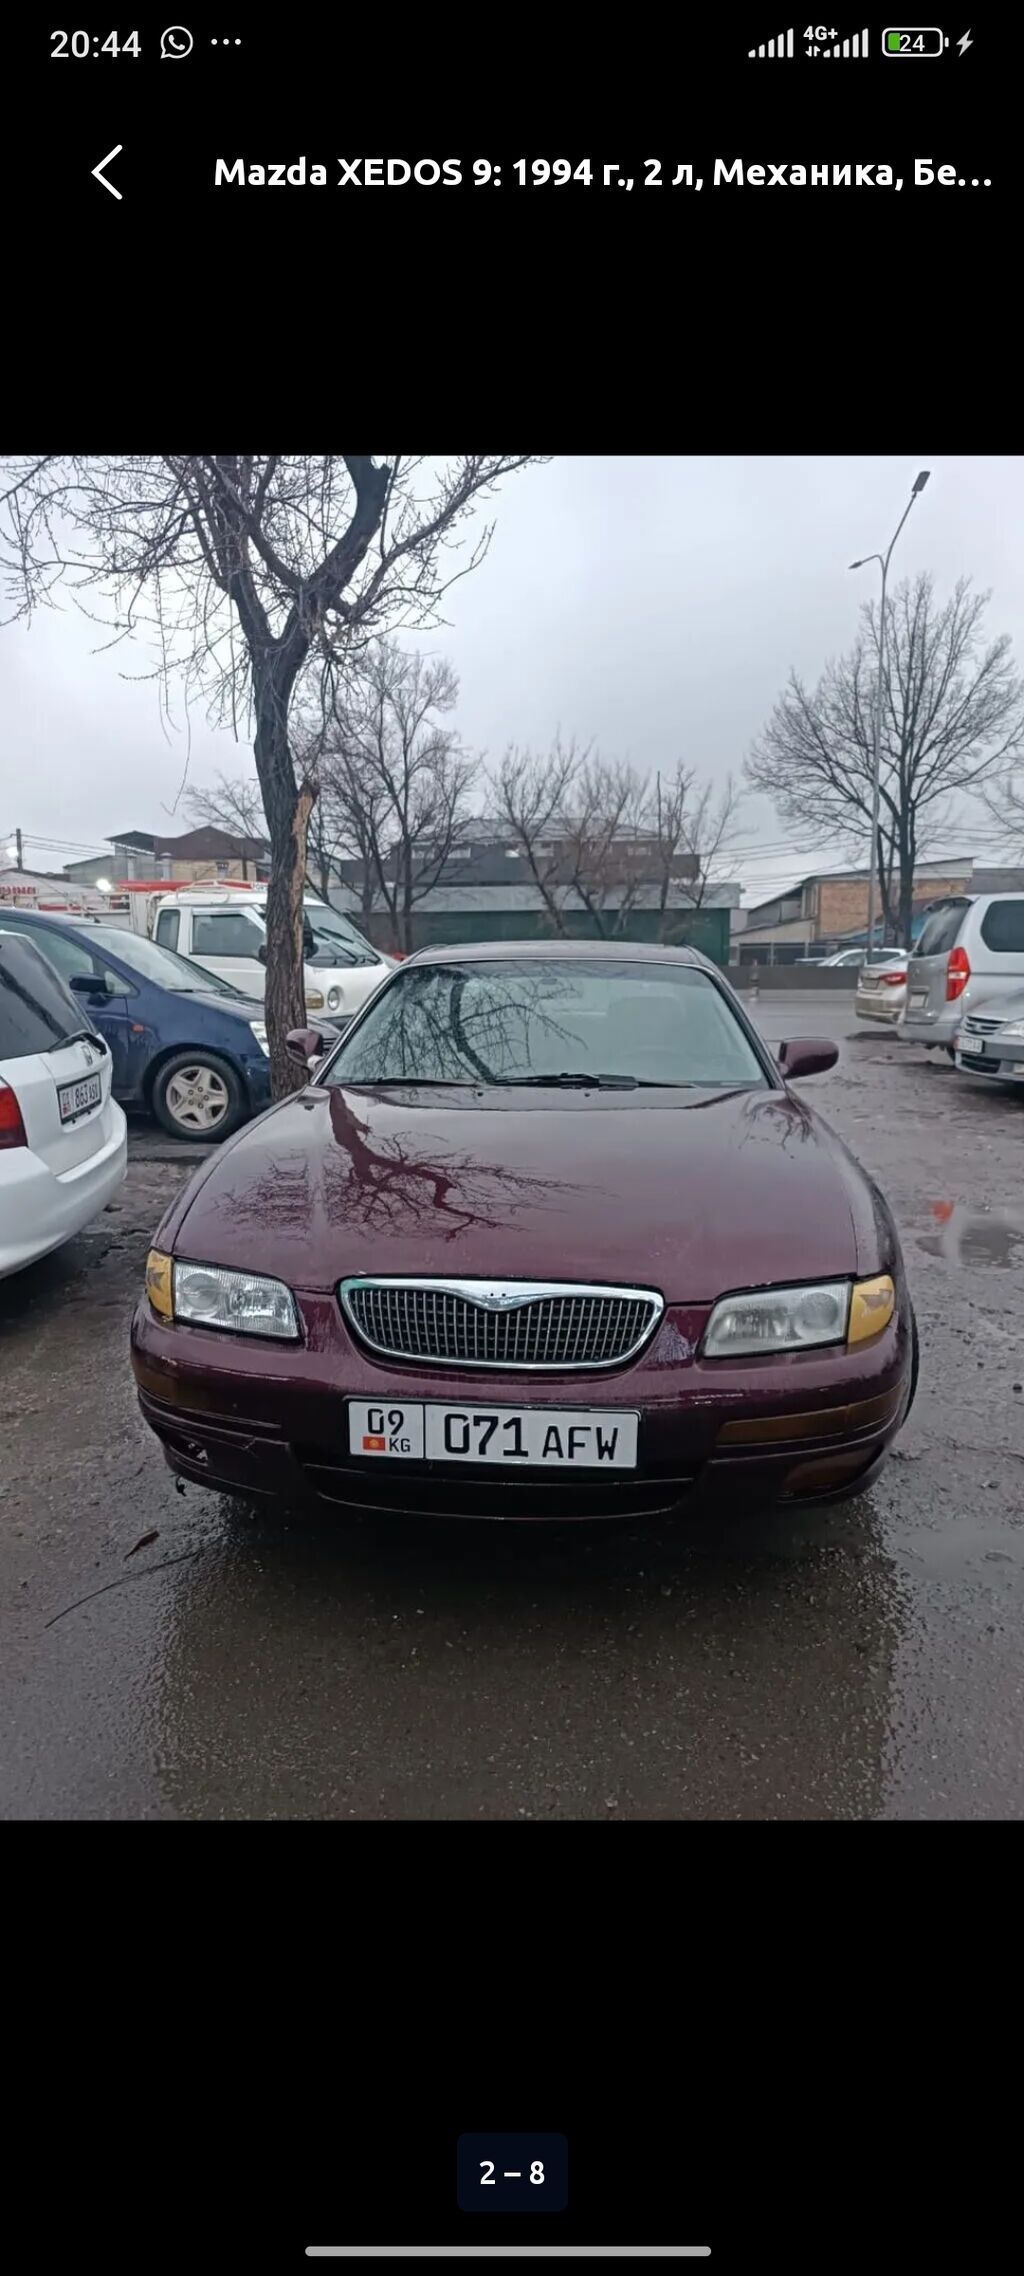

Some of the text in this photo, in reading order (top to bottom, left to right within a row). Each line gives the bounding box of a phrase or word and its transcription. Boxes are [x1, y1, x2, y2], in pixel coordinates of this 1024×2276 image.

[367, 1408, 619, 1461] 09 071 AFW
[389, 1437, 411, 1453] KG
